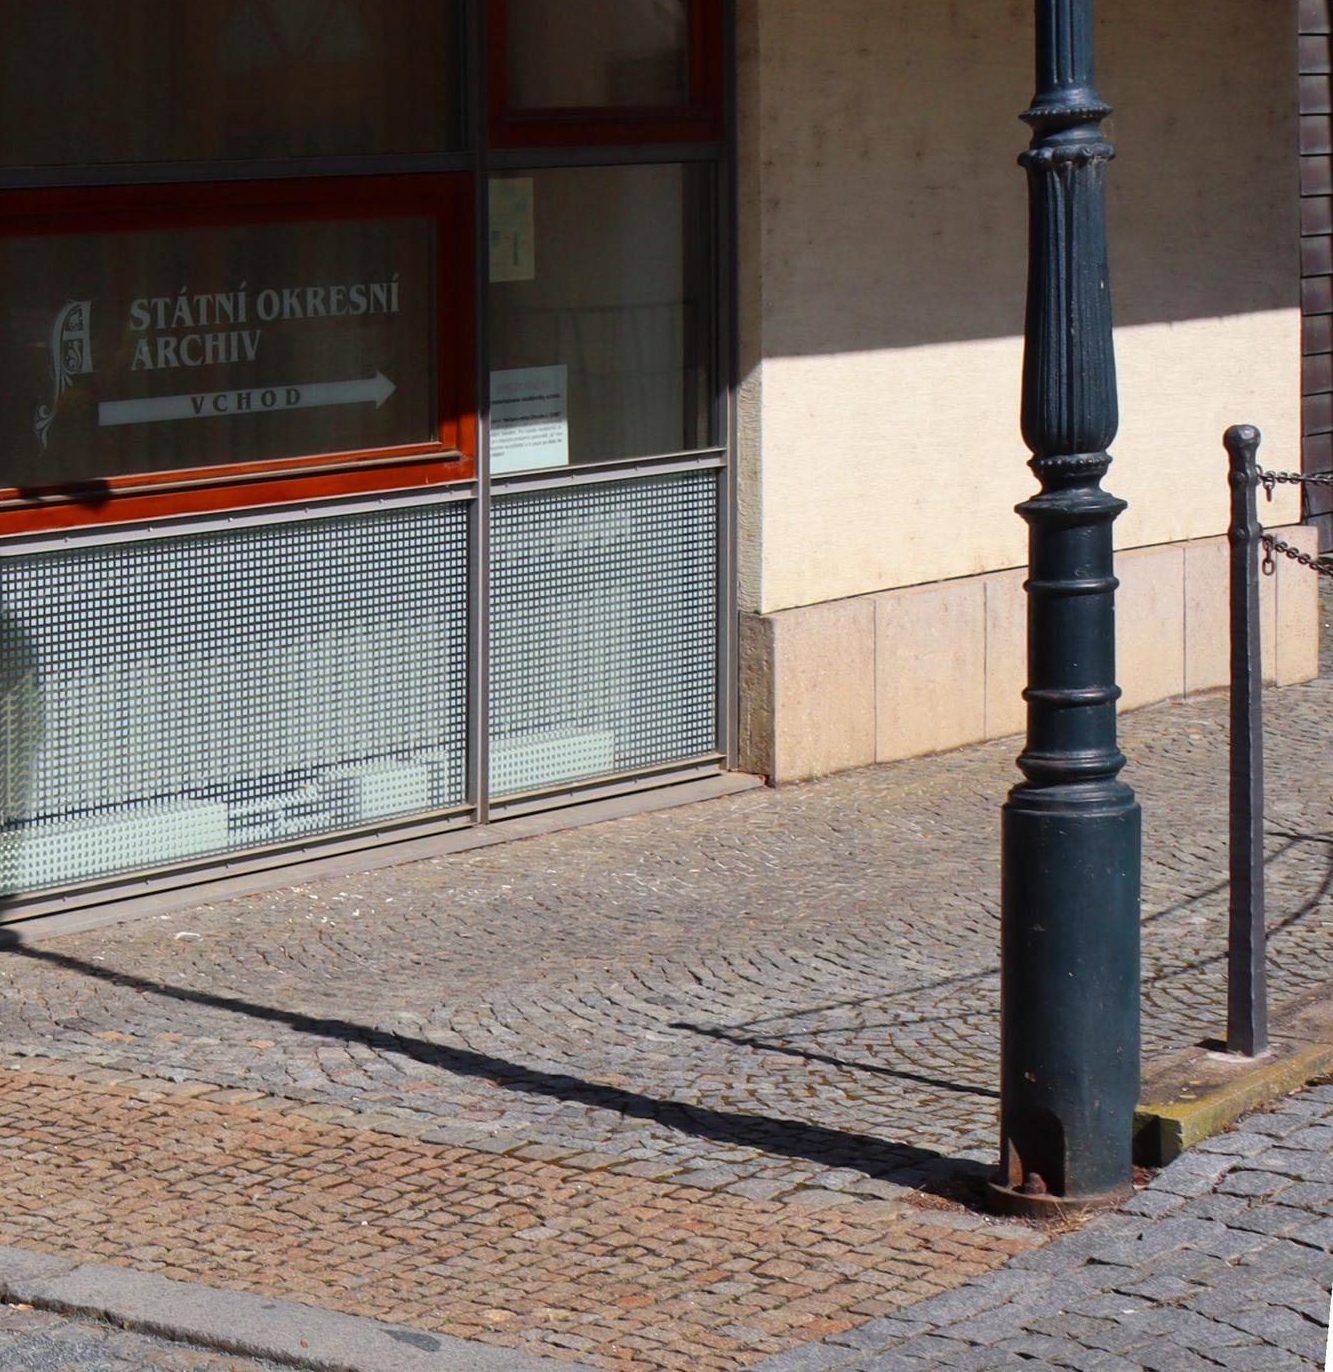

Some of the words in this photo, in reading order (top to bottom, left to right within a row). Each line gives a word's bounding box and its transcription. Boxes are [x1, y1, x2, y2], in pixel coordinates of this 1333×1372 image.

[129, 281, 247, 331] STÁTNÍ
[256, 273, 400, 322] OKRESNÍ
[130, 330, 261, 371] ARCHIV
[190, 388, 301, 415] VCHOD
